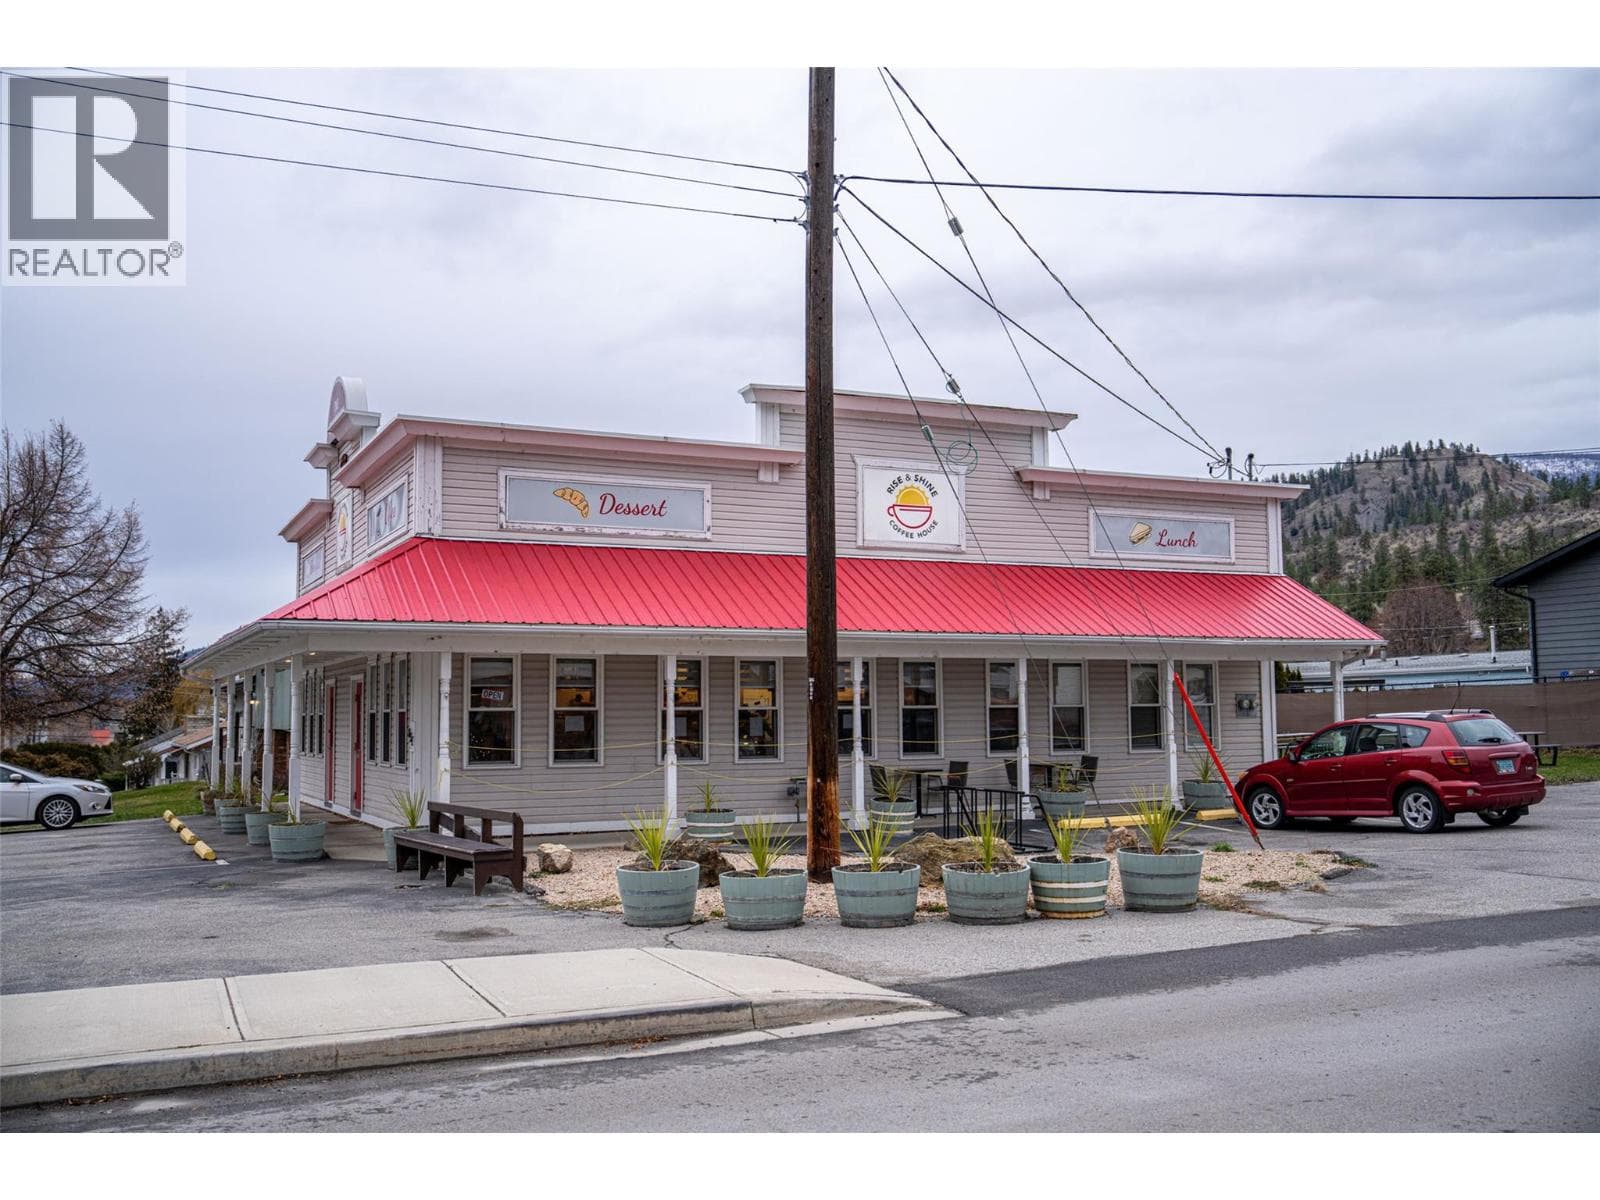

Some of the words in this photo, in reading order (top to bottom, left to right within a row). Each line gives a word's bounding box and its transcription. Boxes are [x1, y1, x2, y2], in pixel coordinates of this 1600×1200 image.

[886, 475, 904, 495] RISE
[905, 473, 912, 482] &
[914, 474, 939, 498] SHINE
[599, 492, 668, 517] Dessert
[889, 519, 914, 539] COFFEE
[917, 519, 939, 539] HOUSE
[1155, 528, 1198, 548] Lunch
[483, 690, 502, 699] OPEN
